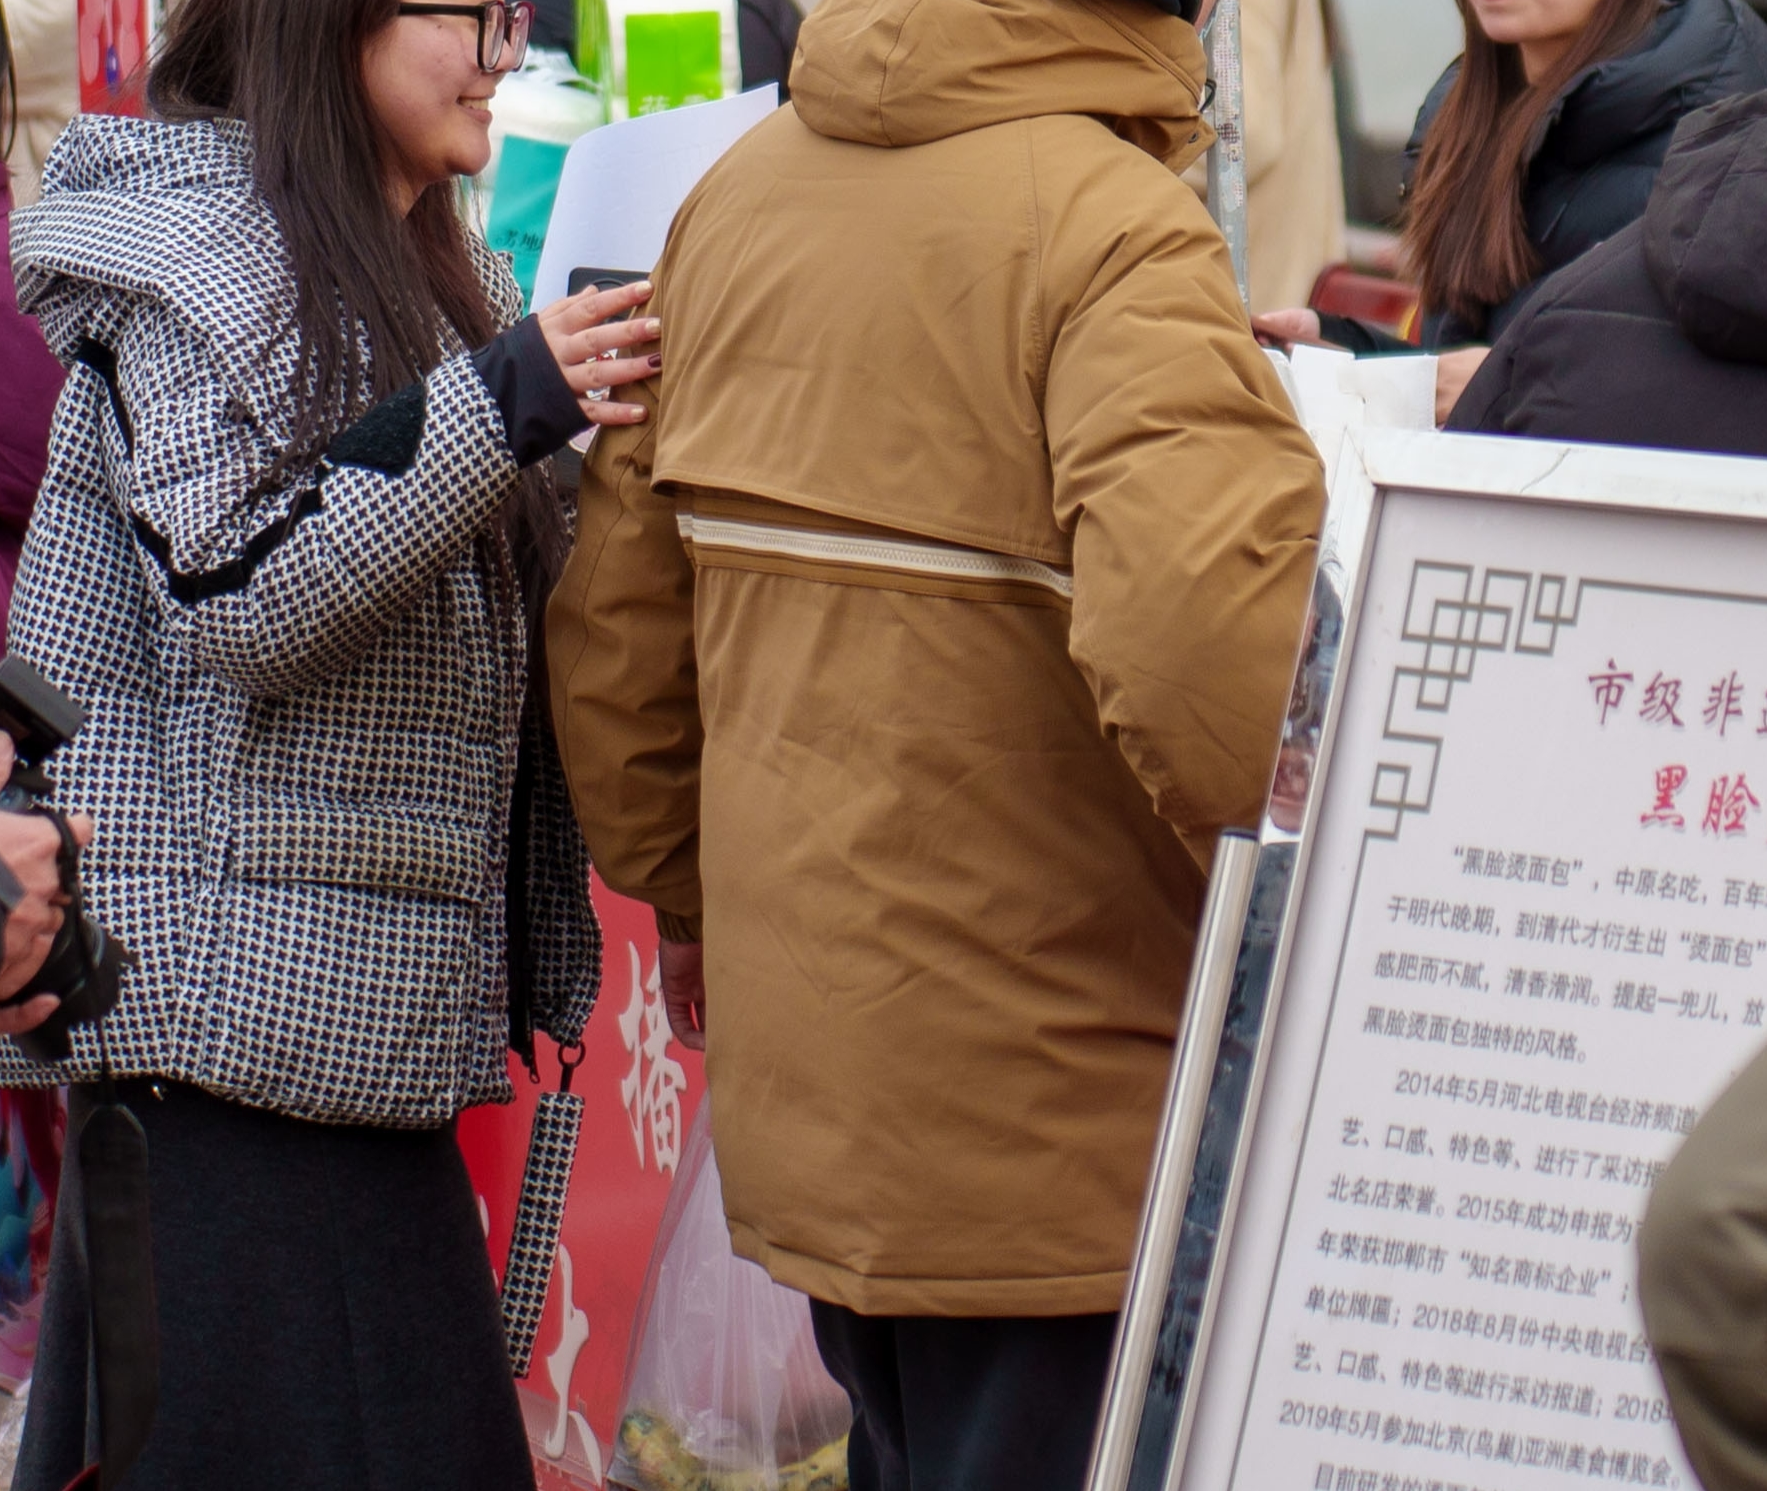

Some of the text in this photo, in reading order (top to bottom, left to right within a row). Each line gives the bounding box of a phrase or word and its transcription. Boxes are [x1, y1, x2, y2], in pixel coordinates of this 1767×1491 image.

[1328, 1173, 1644, 1245] 北名店荣誉。2015年成功申报为
[1305, 1286, 1655, 1365] 单位牌匾；2018年8月份中央电视台
